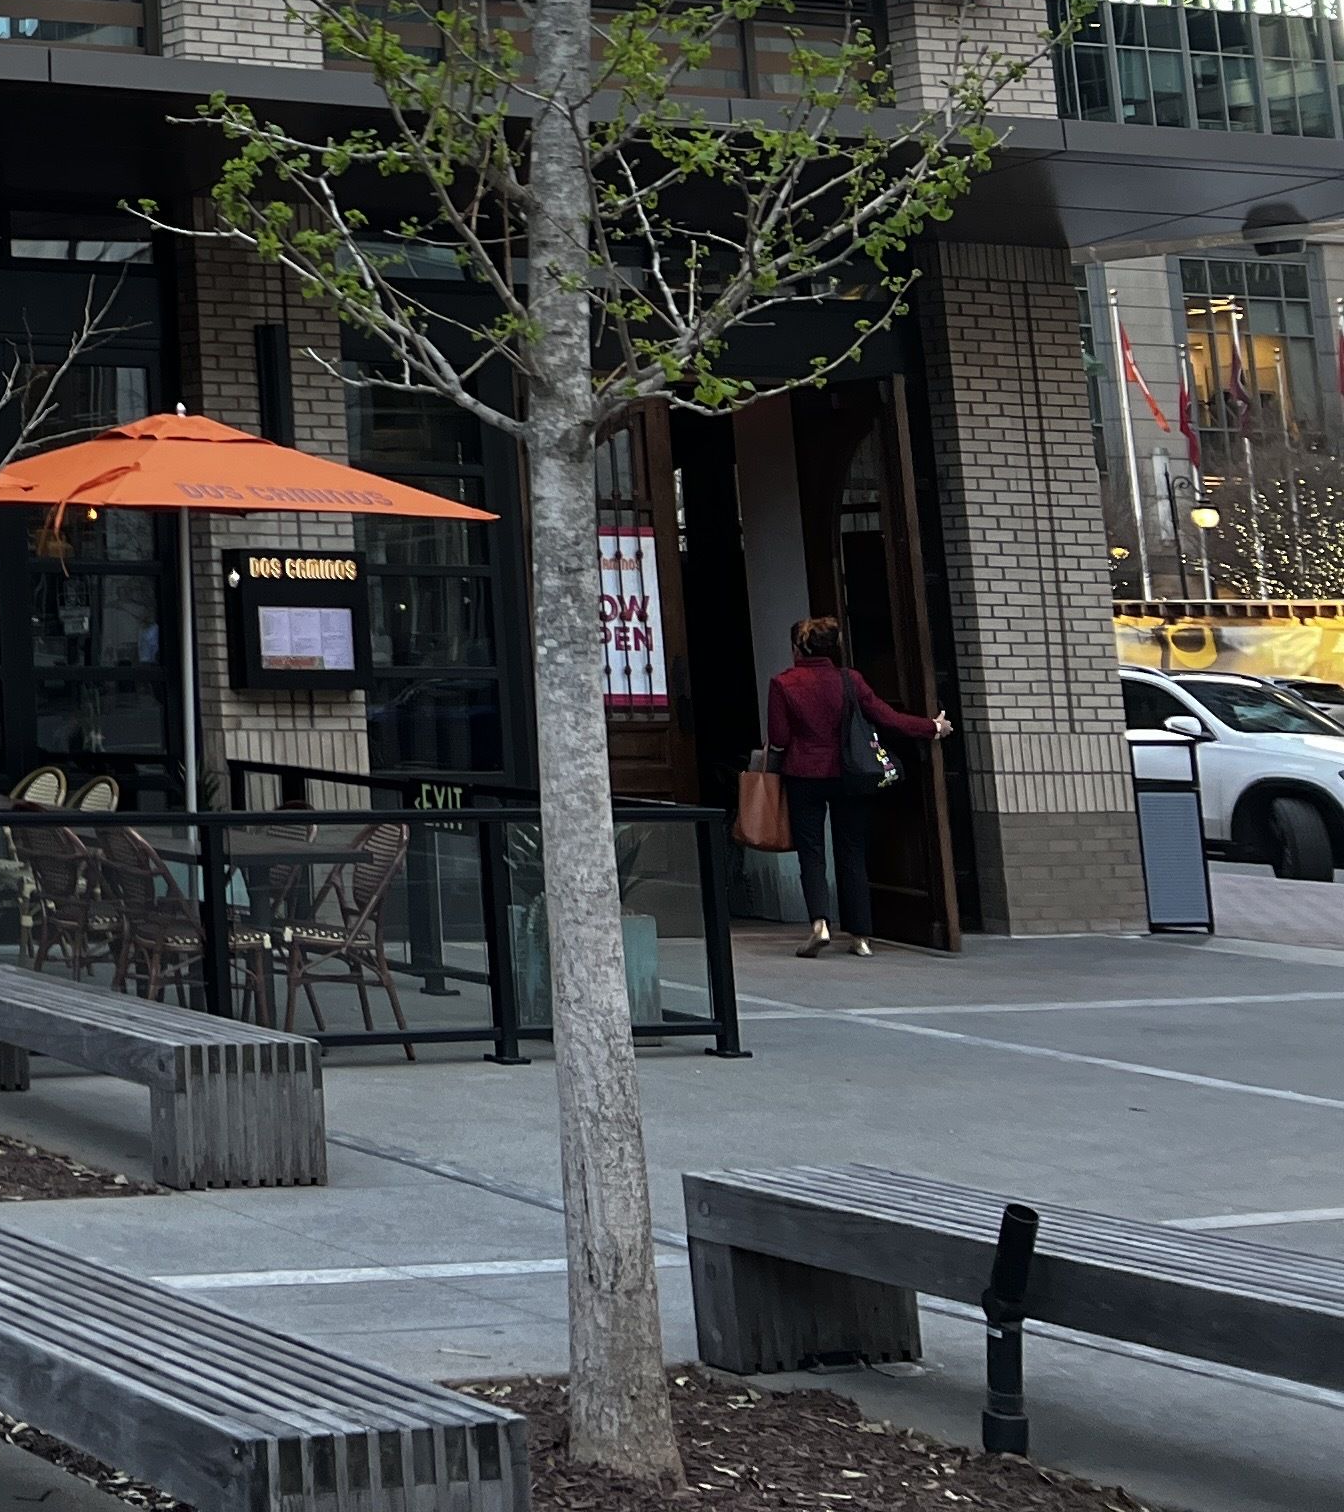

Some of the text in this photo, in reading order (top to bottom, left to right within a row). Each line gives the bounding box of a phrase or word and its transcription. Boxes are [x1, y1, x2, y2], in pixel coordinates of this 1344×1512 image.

[174, 482, 393, 506] DOS CAMINOS
[249, 556, 358, 581] DOS CAMINOS
[599, 594, 650, 622] OW
[599, 626, 654, 651] PEN
